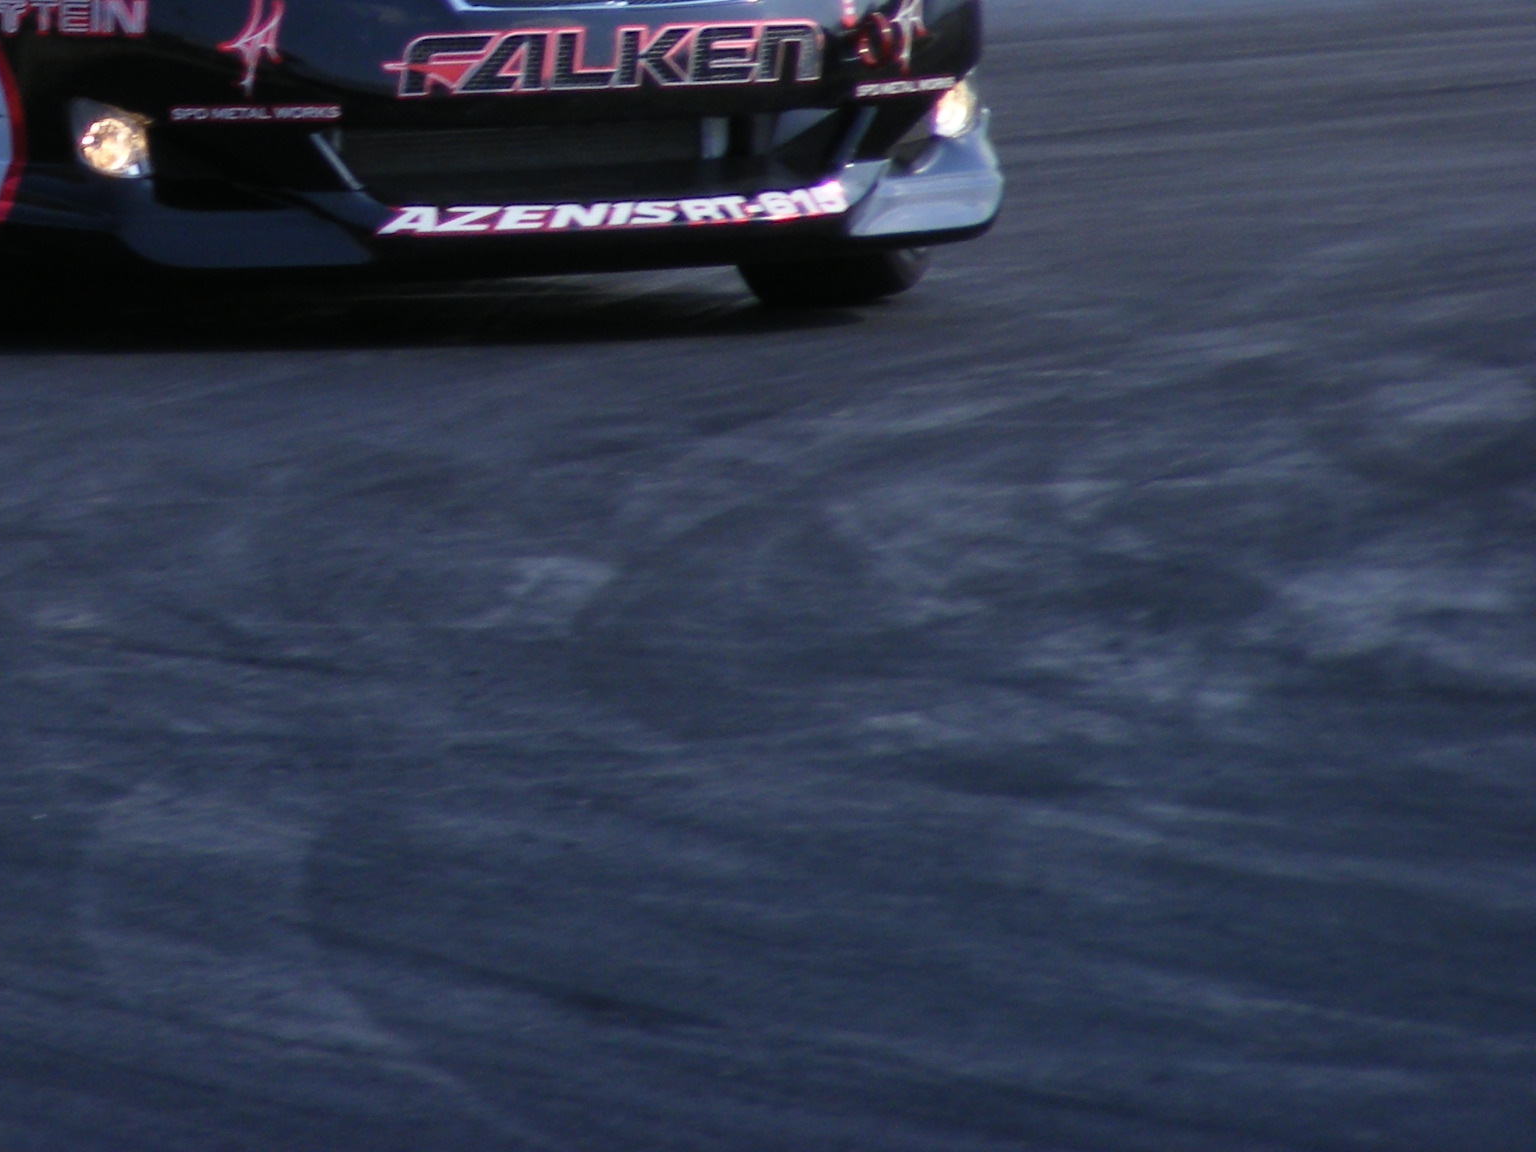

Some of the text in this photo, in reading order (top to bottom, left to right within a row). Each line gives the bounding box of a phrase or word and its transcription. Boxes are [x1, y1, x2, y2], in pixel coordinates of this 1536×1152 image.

[382, 18, 826, 98] FALKEN
[212, 105, 271, 120] METAL
[275, 104, 342, 120] WORKS
[377, 179, 848, 235] AZENIS RT-615
